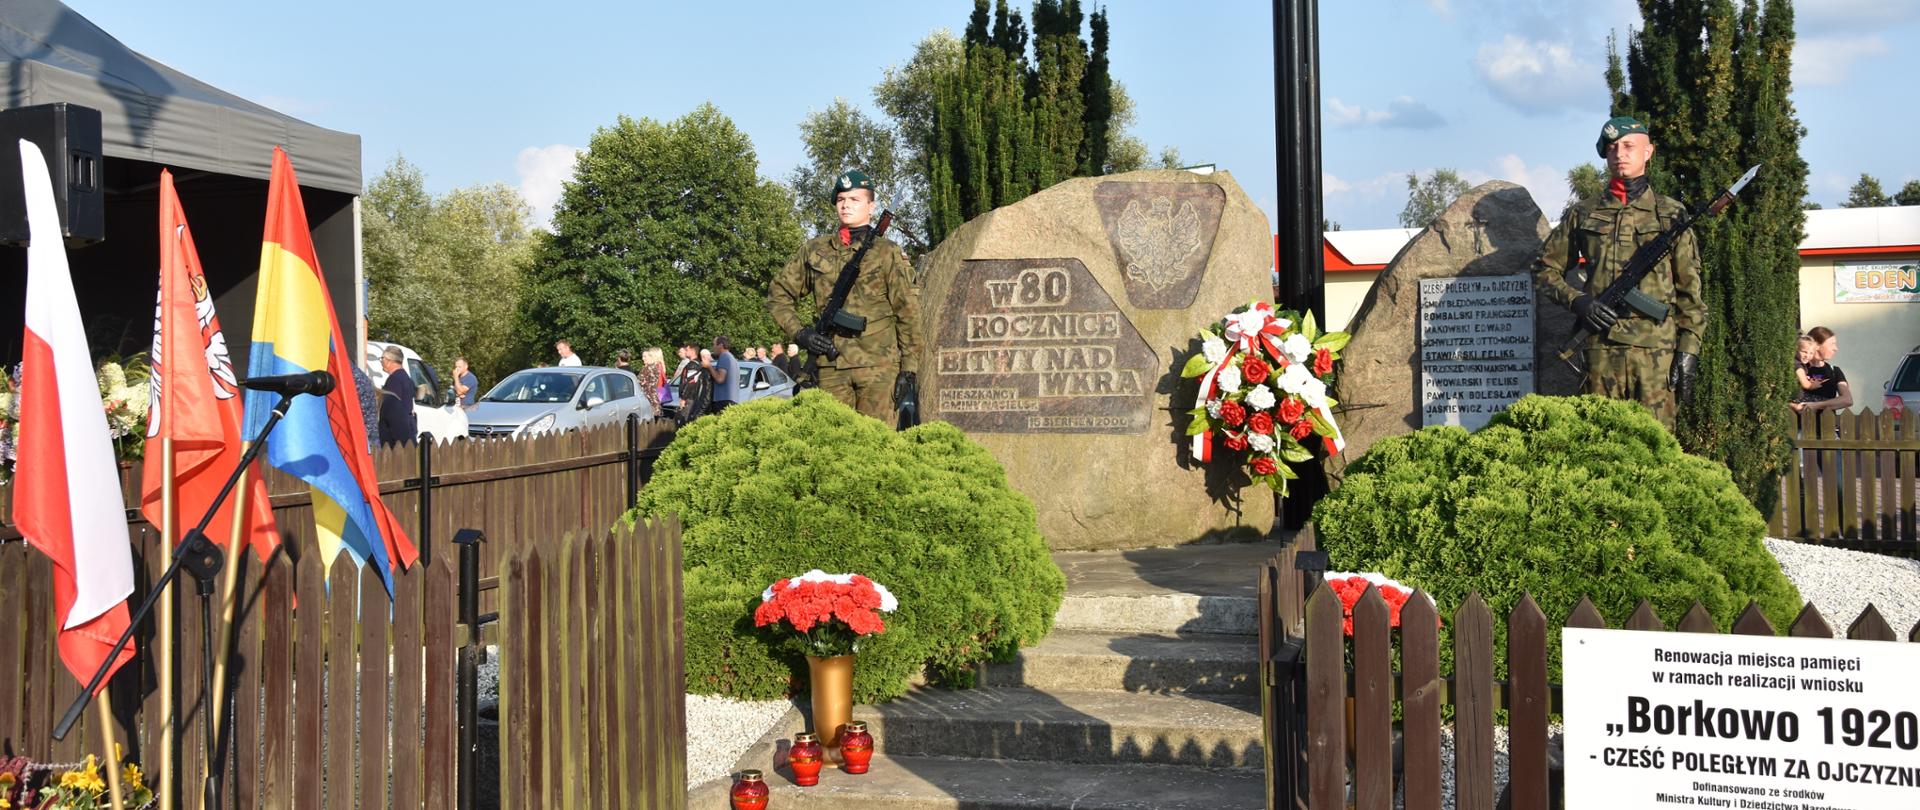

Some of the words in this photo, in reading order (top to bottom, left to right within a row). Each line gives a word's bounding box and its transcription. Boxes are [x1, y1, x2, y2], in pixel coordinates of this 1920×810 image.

[1018, 271, 1068, 304] 80
[1445, 281, 1481, 294] POLEGŁYM
[1855, 270, 1915, 289] EDEN
[1476, 308, 1529, 319] FRANCISZEK
[1474, 323, 1512, 333] EDWARD
[941, 349, 1036, 373] BITWY
[1046, 348, 1113, 370] NAD
[1481, 349, 1515, 359] FELIKS
[1426, 378, 1482, 387] PIWOWARSKI
[1486, 377, 1519, 386] FELIKS
[1426, 391, 1464, 400] PAWLAK
[1469, 390, 1520, 400] BOLESŁAW
[942, 400, 980, 411] GMINY
[1095, 416, 1128, 427] 2000
[1654, 648, 1733, 667] Renowacja
[1738, 652, 1795, 668] miejsca
[1800, 656, 1861, 673] pamięci
[1652, 671, 1664, 683] w
[1669, 672, 1723, 686] ramach
[1728, 674, 1796, 691] realizacji
[1800, 677, 1863, 693] wniosku
[1816, 707, 1919, 750] 1920
[1603, 745, 1665, 769] CZEŚĆ
[1672, 750, 1777, 778] POLEGŁYM
[1783, 758, 1810, 779] ZA
[1692, 781, 1766, 796] Dofinansowano
[1768, 788, 1780, 797] ze
[1783, 788, 1825, 800] środków
[1656, 793, 1695, 805] Ministra
[1697, 795, 1731, 808] Kultury
[1733, 798, 1737, 808] i
[1740, 799, 1799, 810] Dziedzictwa
